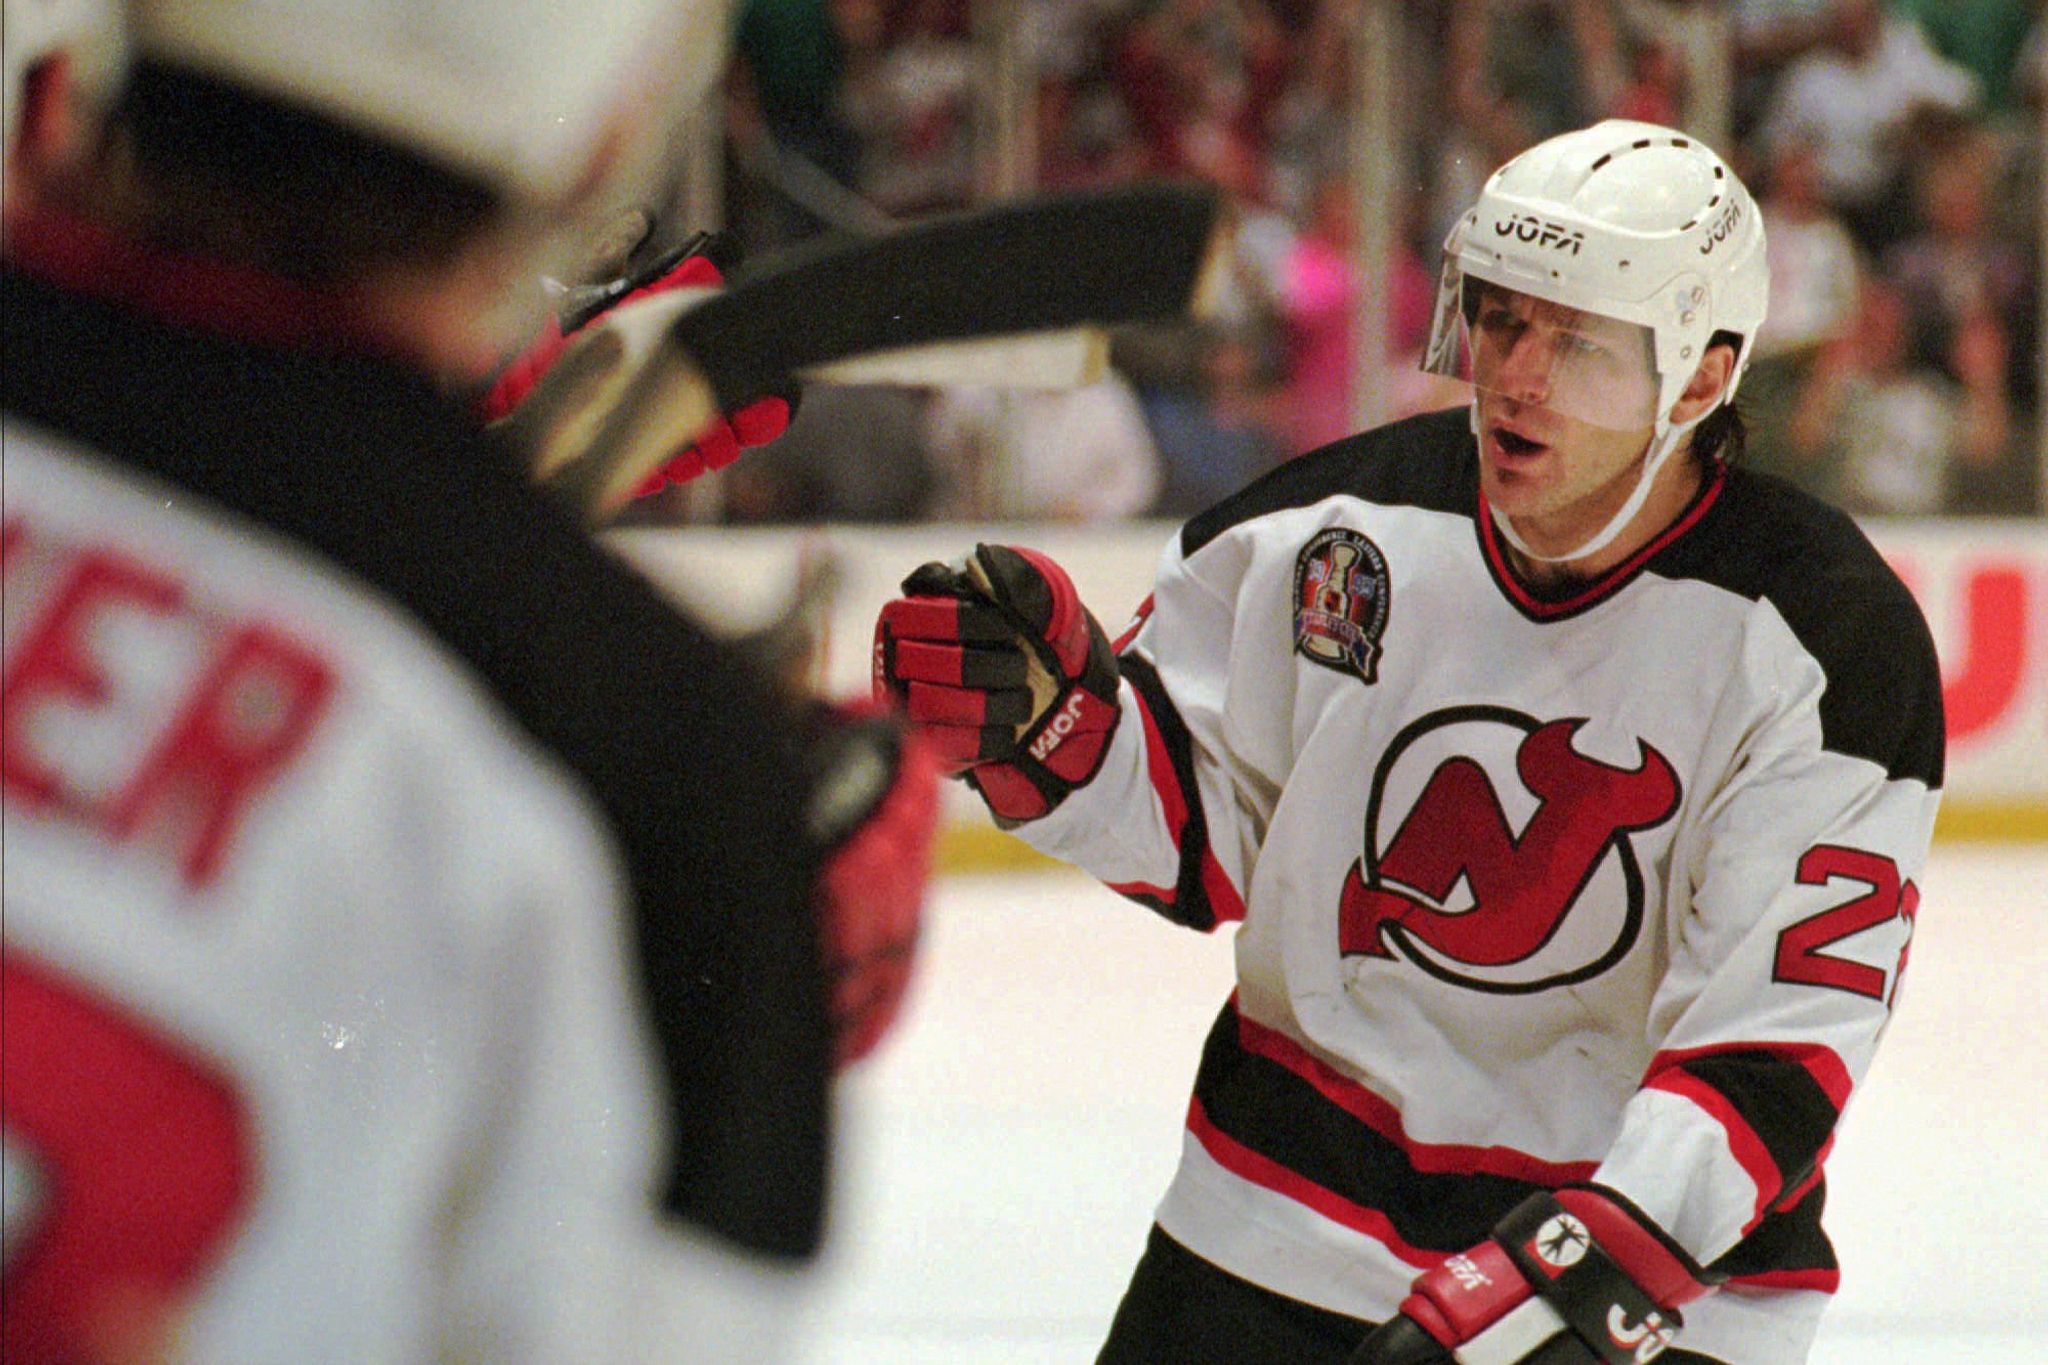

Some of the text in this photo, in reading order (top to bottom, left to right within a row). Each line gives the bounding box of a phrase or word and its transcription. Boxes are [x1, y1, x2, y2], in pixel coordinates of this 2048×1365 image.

[1495, 214, 1585, 256] JOFA
[1700, 197, 1741, 255] JOFA
[0, 515, 338, 892] ER
[1771, 843, 1920, 1010] 2
